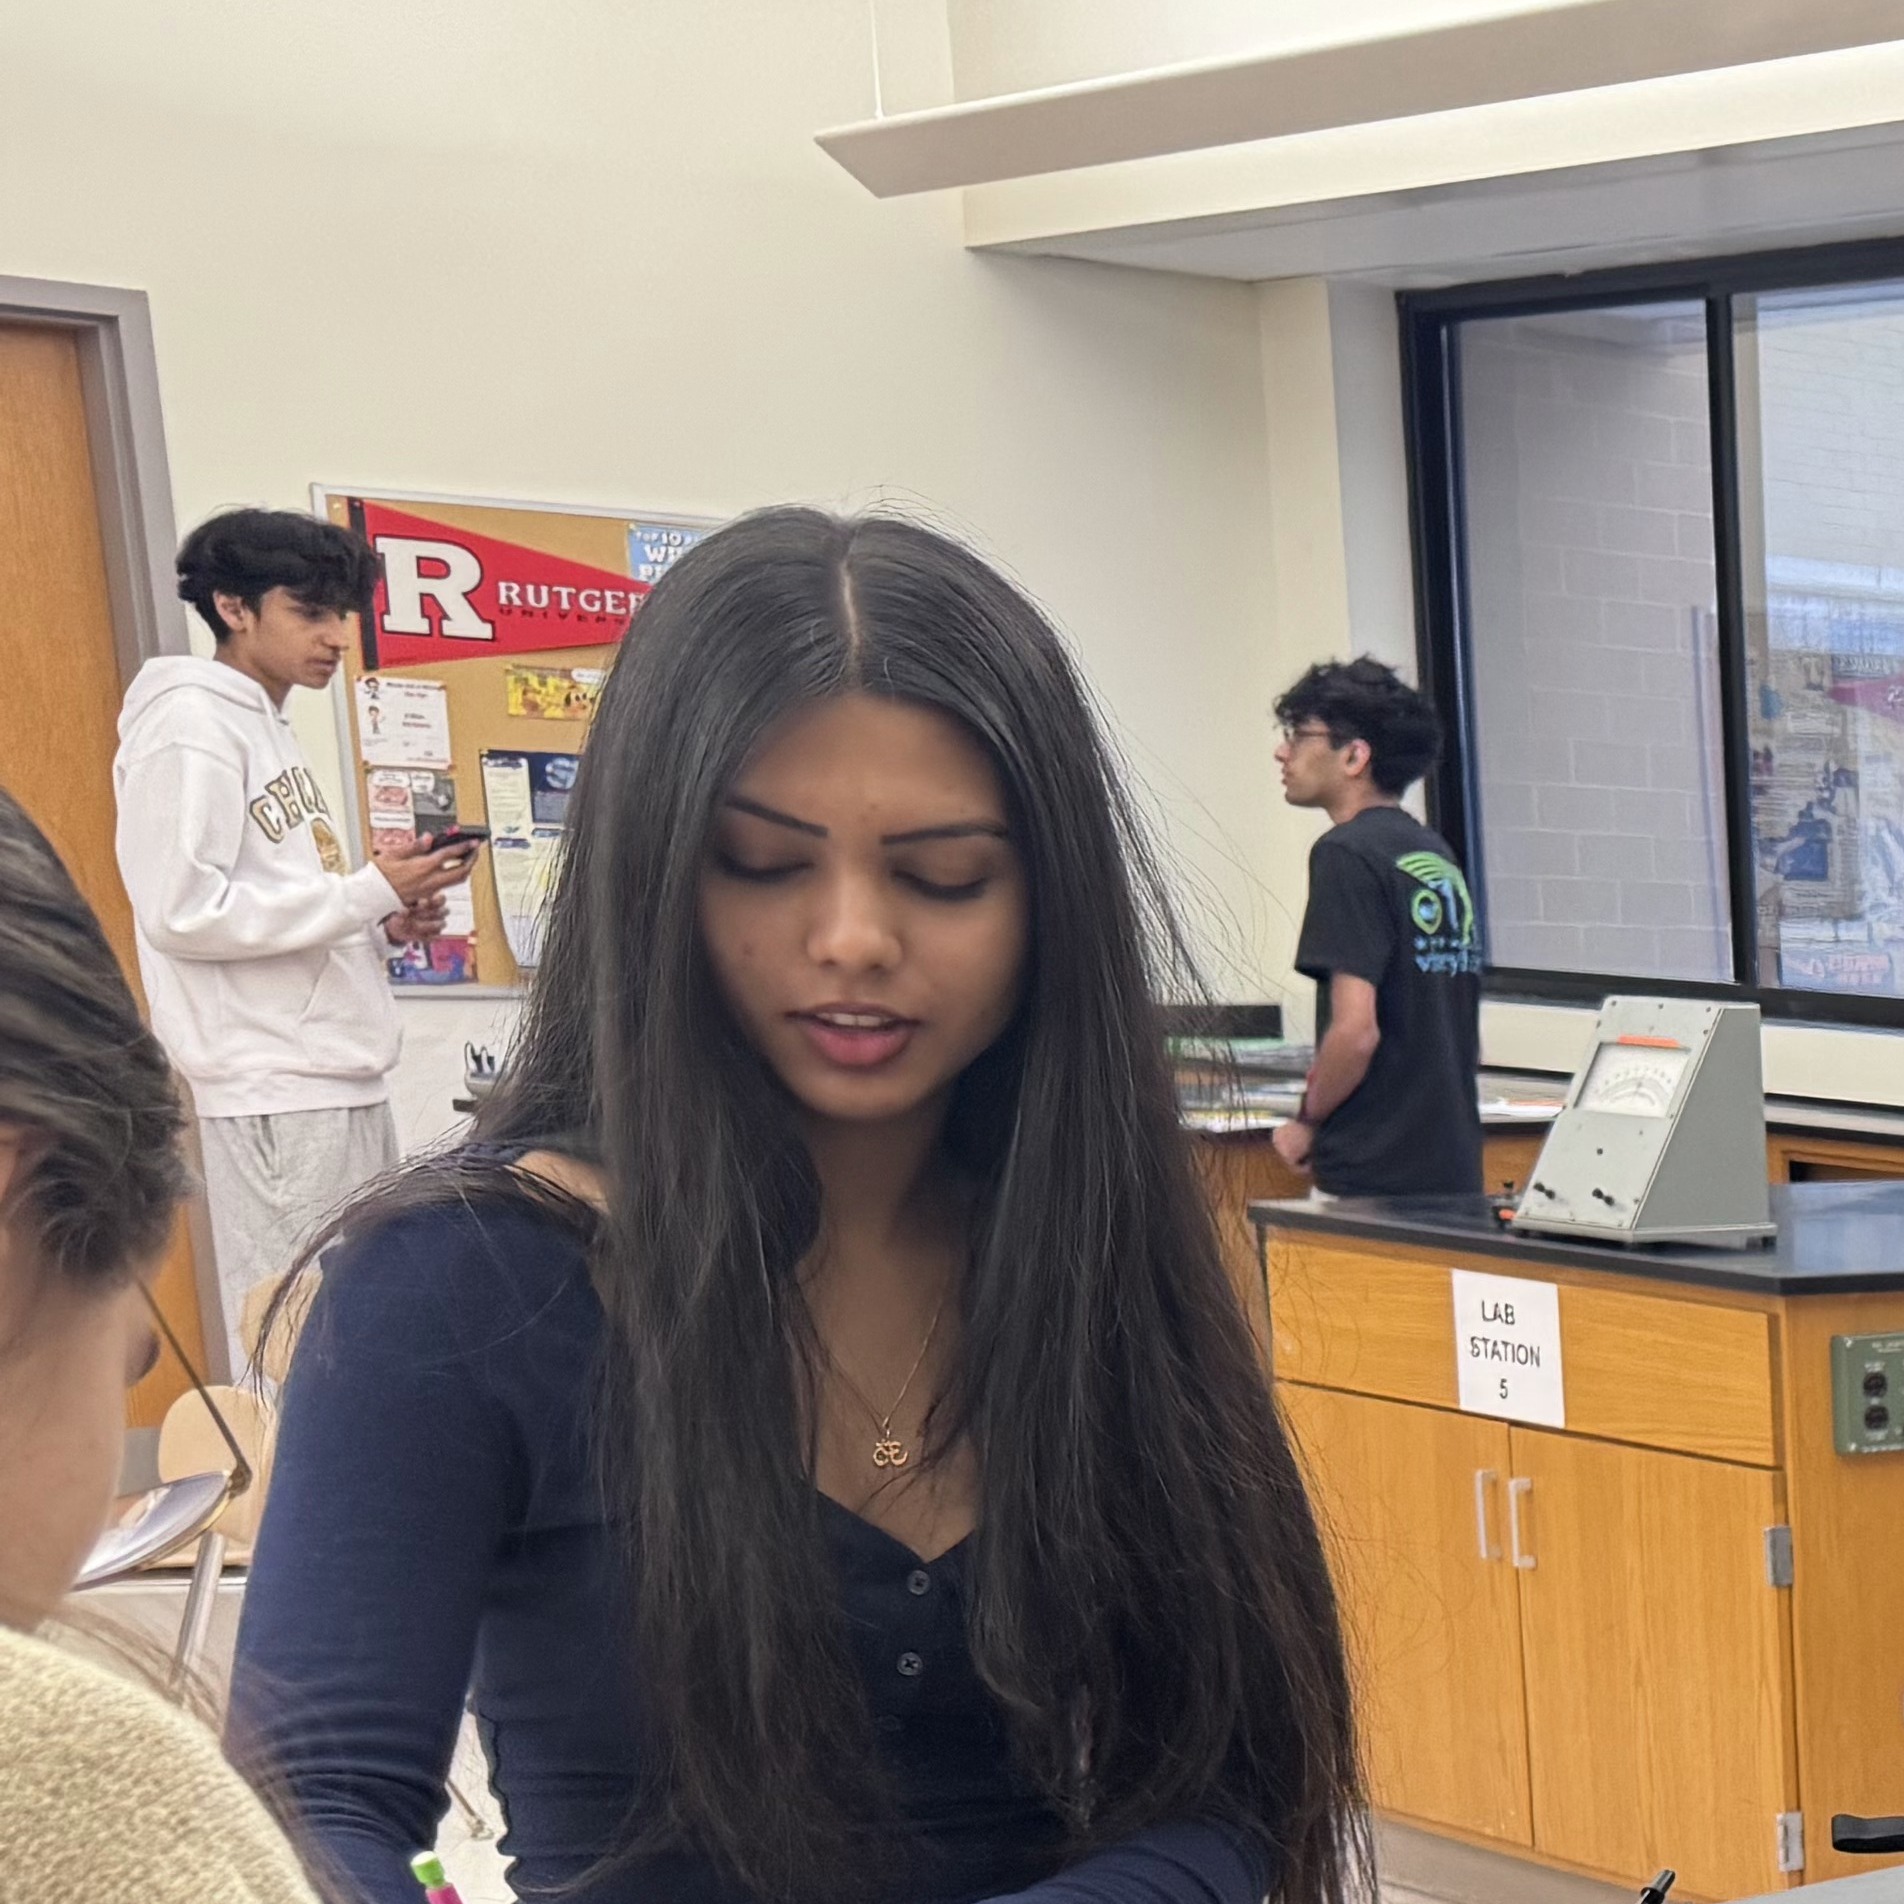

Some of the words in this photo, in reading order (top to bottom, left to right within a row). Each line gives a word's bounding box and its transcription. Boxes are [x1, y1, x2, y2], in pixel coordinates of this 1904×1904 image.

[375, 535, 495, 641] R
[1481, 1300, 1515, 1325] LAB
[1470, 1336, 1541, 1368] STATION
[1499, 1378, 1509, 1399] 5
